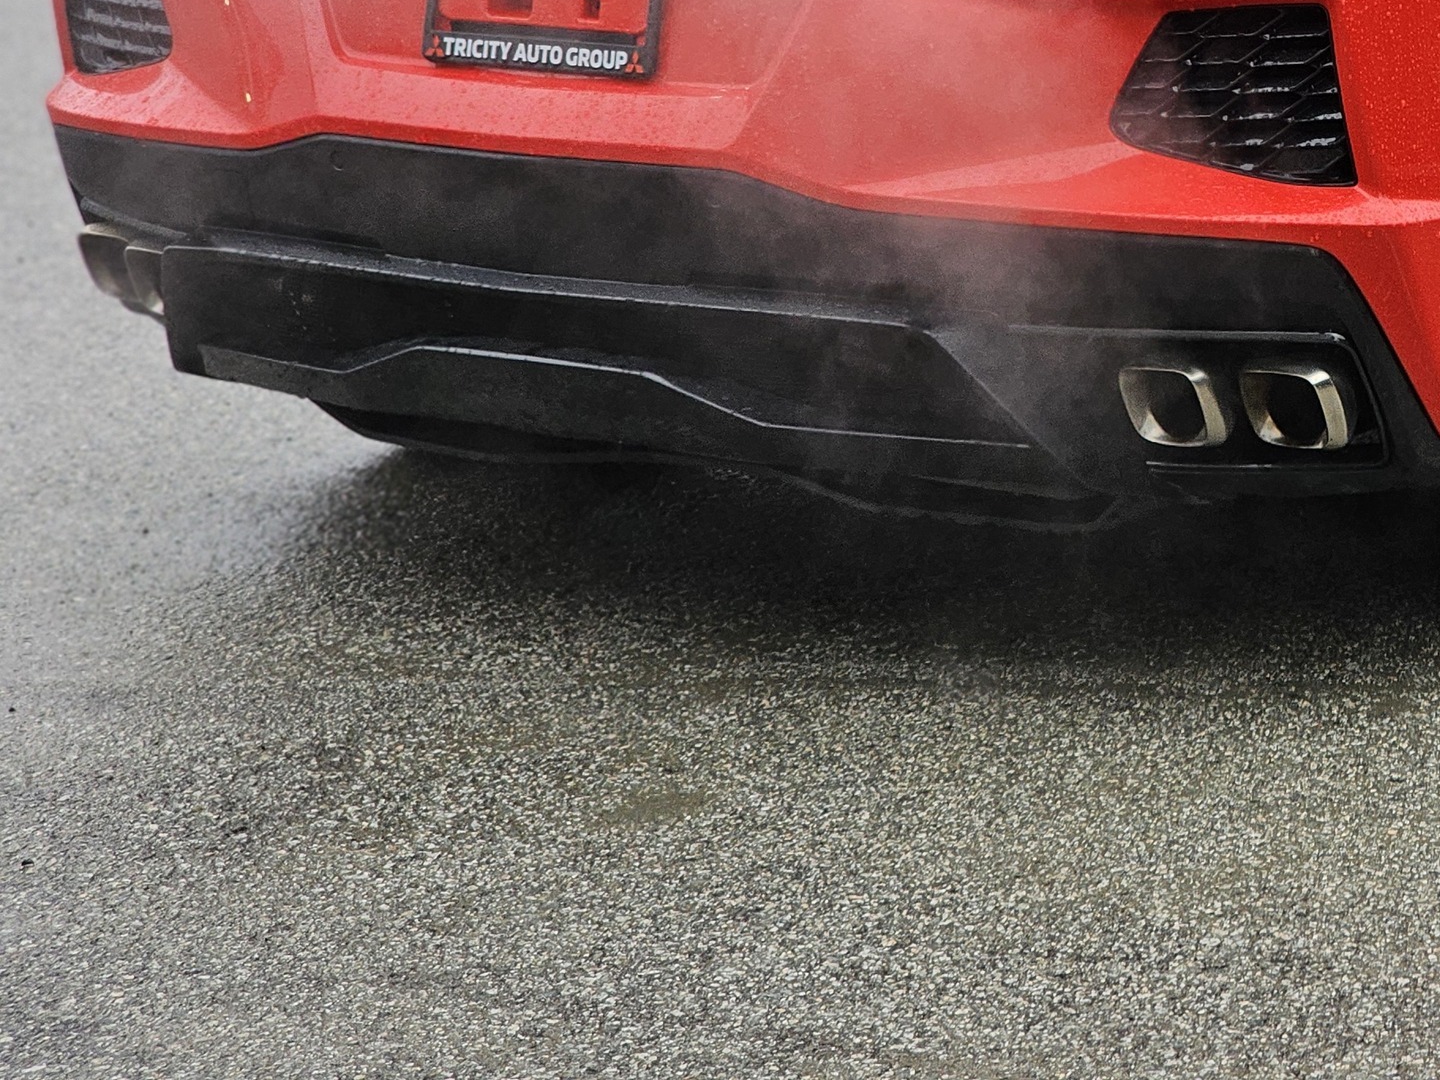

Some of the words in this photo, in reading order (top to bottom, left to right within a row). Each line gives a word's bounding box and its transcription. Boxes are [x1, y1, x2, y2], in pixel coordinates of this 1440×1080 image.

[443, 36, 512, 60] TRICITY
[513, 42, 563, 65] AUTO
[565, 47, 628, 70] GROUP
